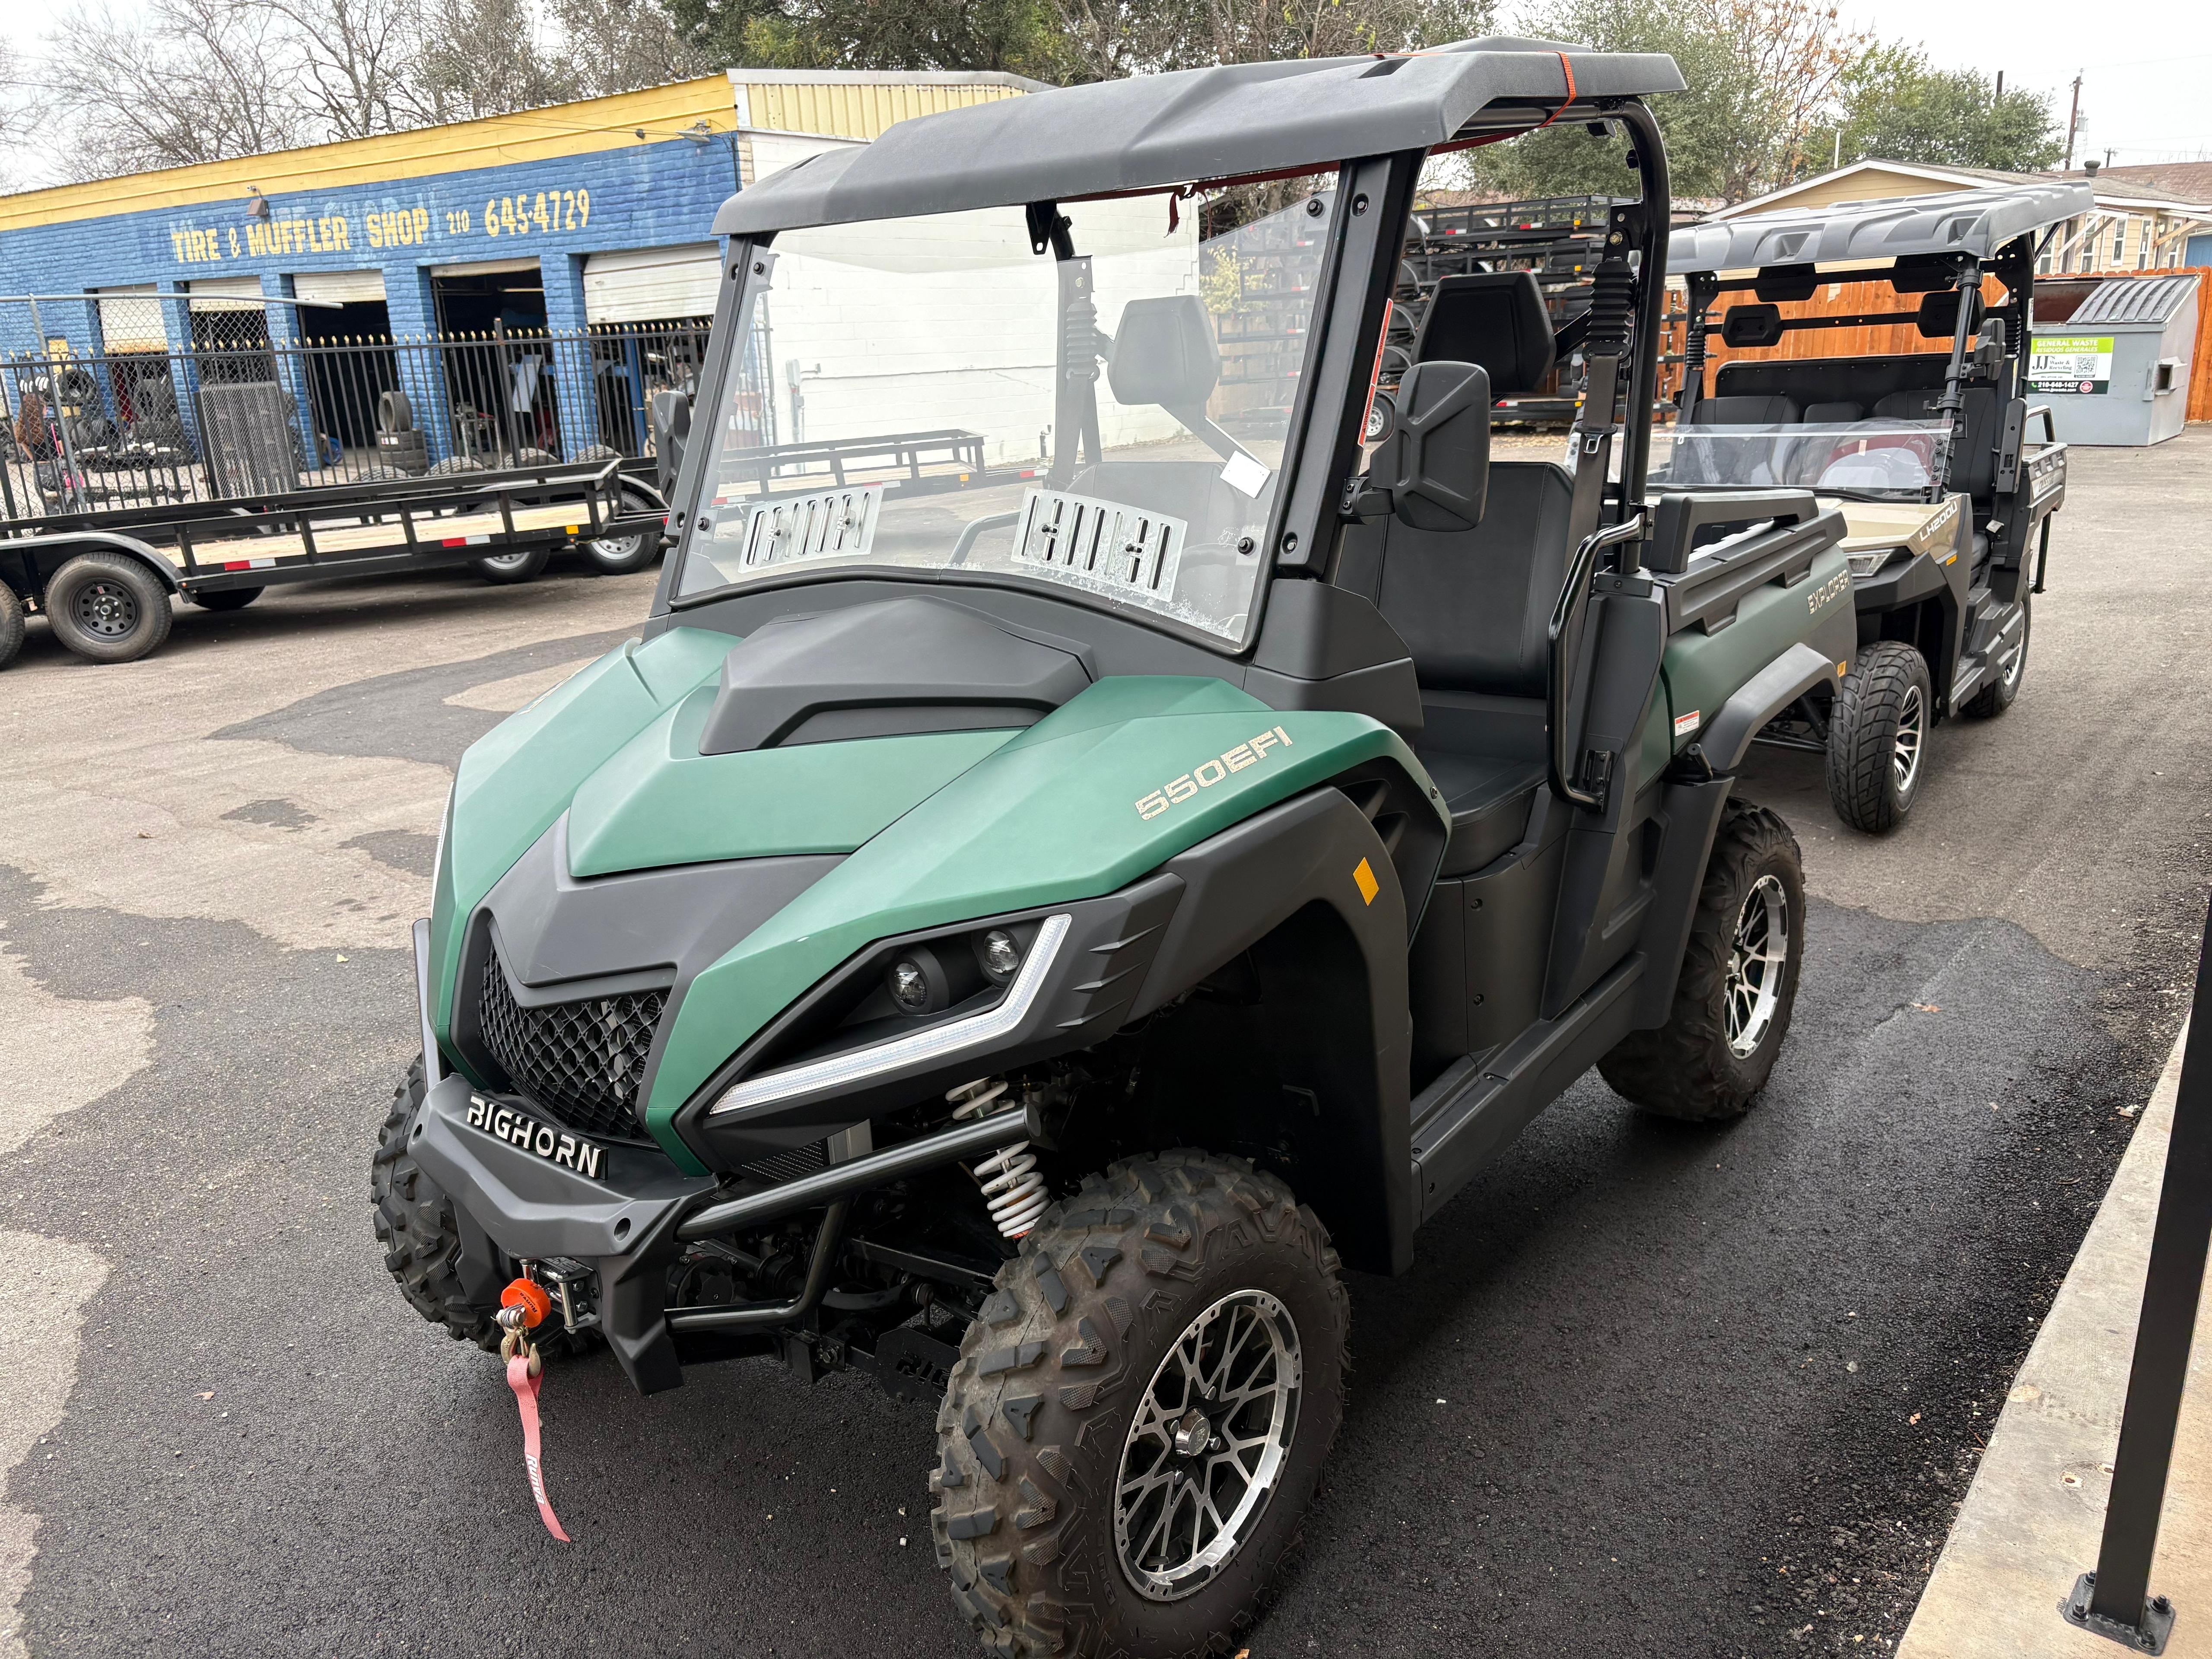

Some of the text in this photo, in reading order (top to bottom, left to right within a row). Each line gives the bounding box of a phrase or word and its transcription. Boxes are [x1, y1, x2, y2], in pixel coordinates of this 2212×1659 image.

[172, 228, 221, 263] TIRE
[228, 227, 241, 258] &
[245, 216, 351, 257] MUFFLER
[366, 208, 429, 248] SHOP
[446, 209, 470, 235] 210
[1919, 501, 1958, 542] LH200U
[1807, 569, 1850, 615] EXPLORER
[1135, 725, 1293, 820] 550EFI
[467, 1095, 601, 1179] BIGHORN
[520, 1292, 537, 1313] Runva
[526, 1453, 546, 1505] Runva
